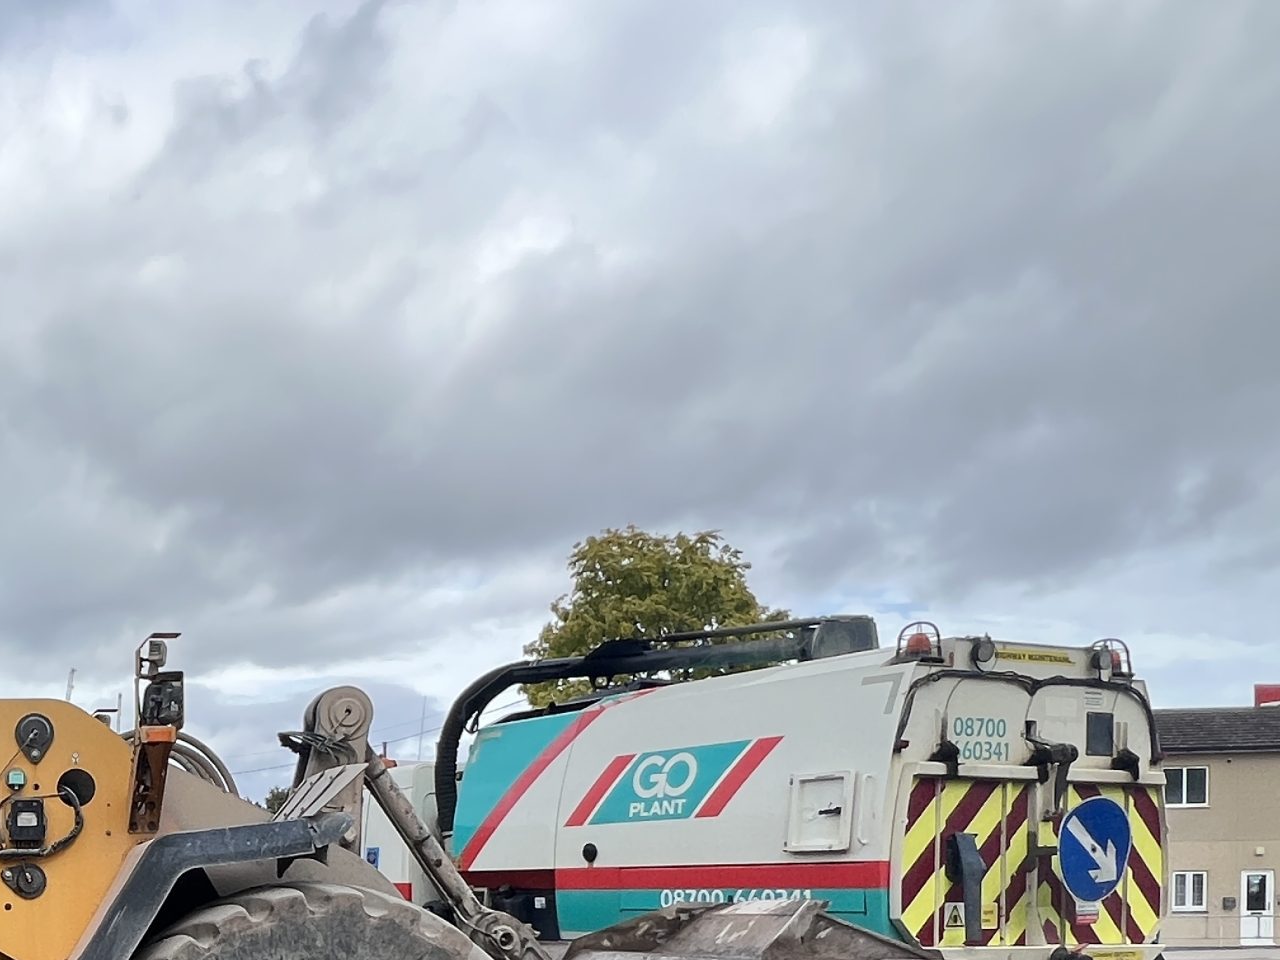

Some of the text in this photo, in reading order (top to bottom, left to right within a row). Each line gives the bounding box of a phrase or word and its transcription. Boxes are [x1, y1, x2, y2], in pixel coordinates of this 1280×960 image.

[954, 717, 1006, 737] 08700
[955, 741, 1009, 761] 60341
[633, 752, 697, 798] GO
[629, 799, 686, 817] PLANT
[660, 889, 724, 908] 08700
